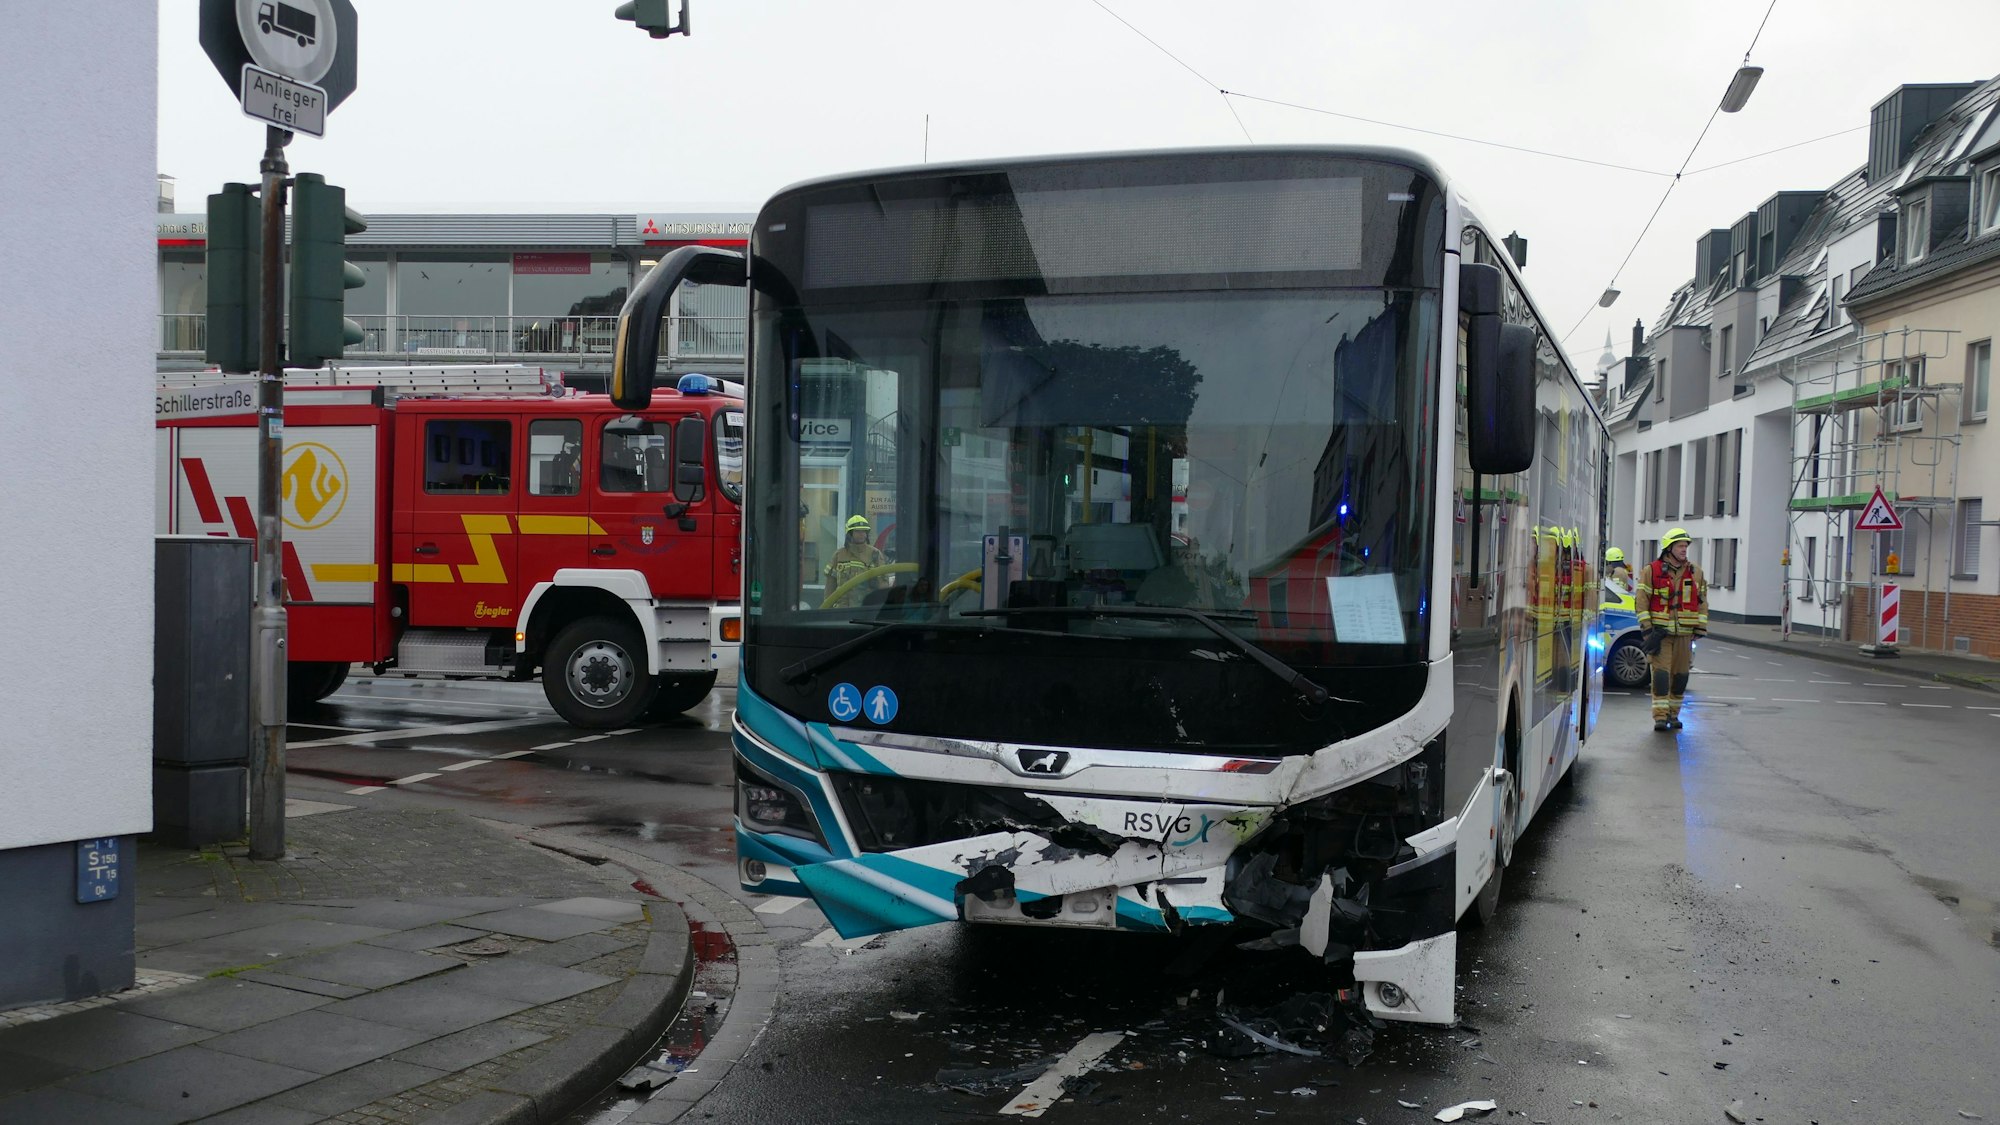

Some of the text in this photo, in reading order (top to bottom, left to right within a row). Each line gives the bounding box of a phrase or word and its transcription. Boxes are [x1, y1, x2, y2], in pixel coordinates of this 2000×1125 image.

[254, 76, 317, 108] Anlieger
[273, 104, 296, 124] frei
[664, 223, 725, 234] MITSUBISHI
[156, 390, 252, 413] Schillerstraße
[474, 601, 513, 619] Ziegler
[1124, 811, 1191, 834] RSVG
[89, 851, 117, 866] S 150
